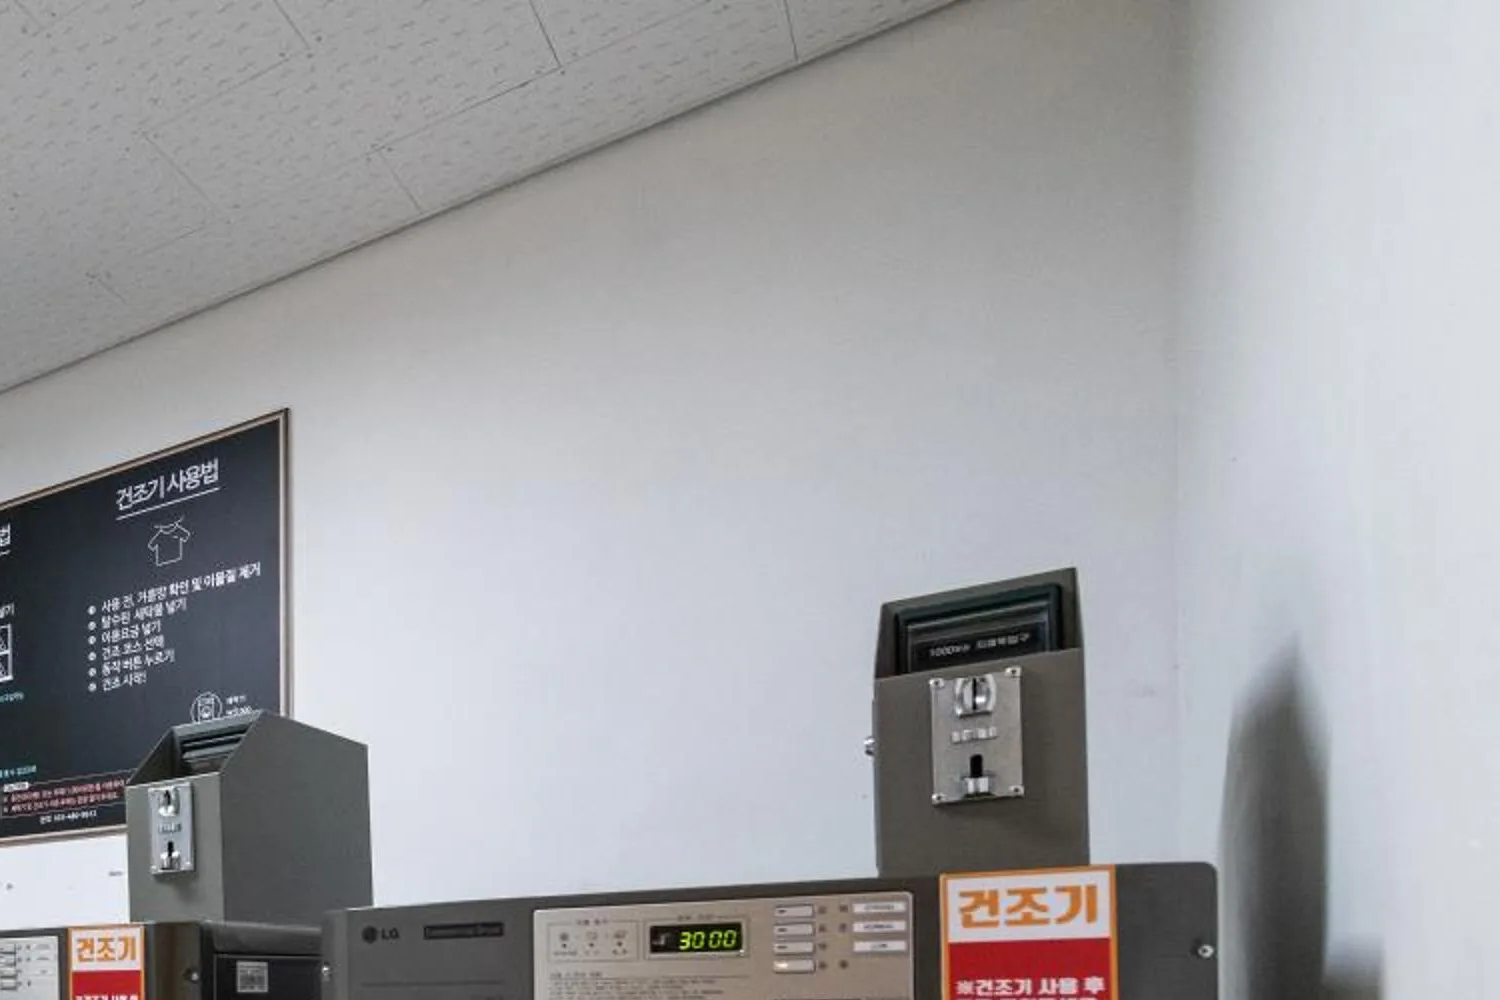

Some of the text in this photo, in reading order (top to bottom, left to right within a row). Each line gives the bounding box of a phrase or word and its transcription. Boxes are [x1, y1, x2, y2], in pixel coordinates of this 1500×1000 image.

[116, 457, 220, 511] 건조기 사용법
[169, 579, 190, 596] 확인
[191, 576, 203, 592] 및
[165, 597, 188, 615] 넣기
[141, 619, 162, 635] 넣기
[102, 645, 121, 661] 건조
[143, 634, 165, 651] 선택
[102, 660, 121, 676] 동작
[123, 655, 142, 670] 버튼
[102, 677, 121, 692] 건조
[957, 884, 1099, 930] 건조기
[381, 927, 400, 940] LG
[76, 935, 137, 962] 건조기
[1038, 977, 1079, 996] 사용
[1083, 977, 1107, 995] 후
